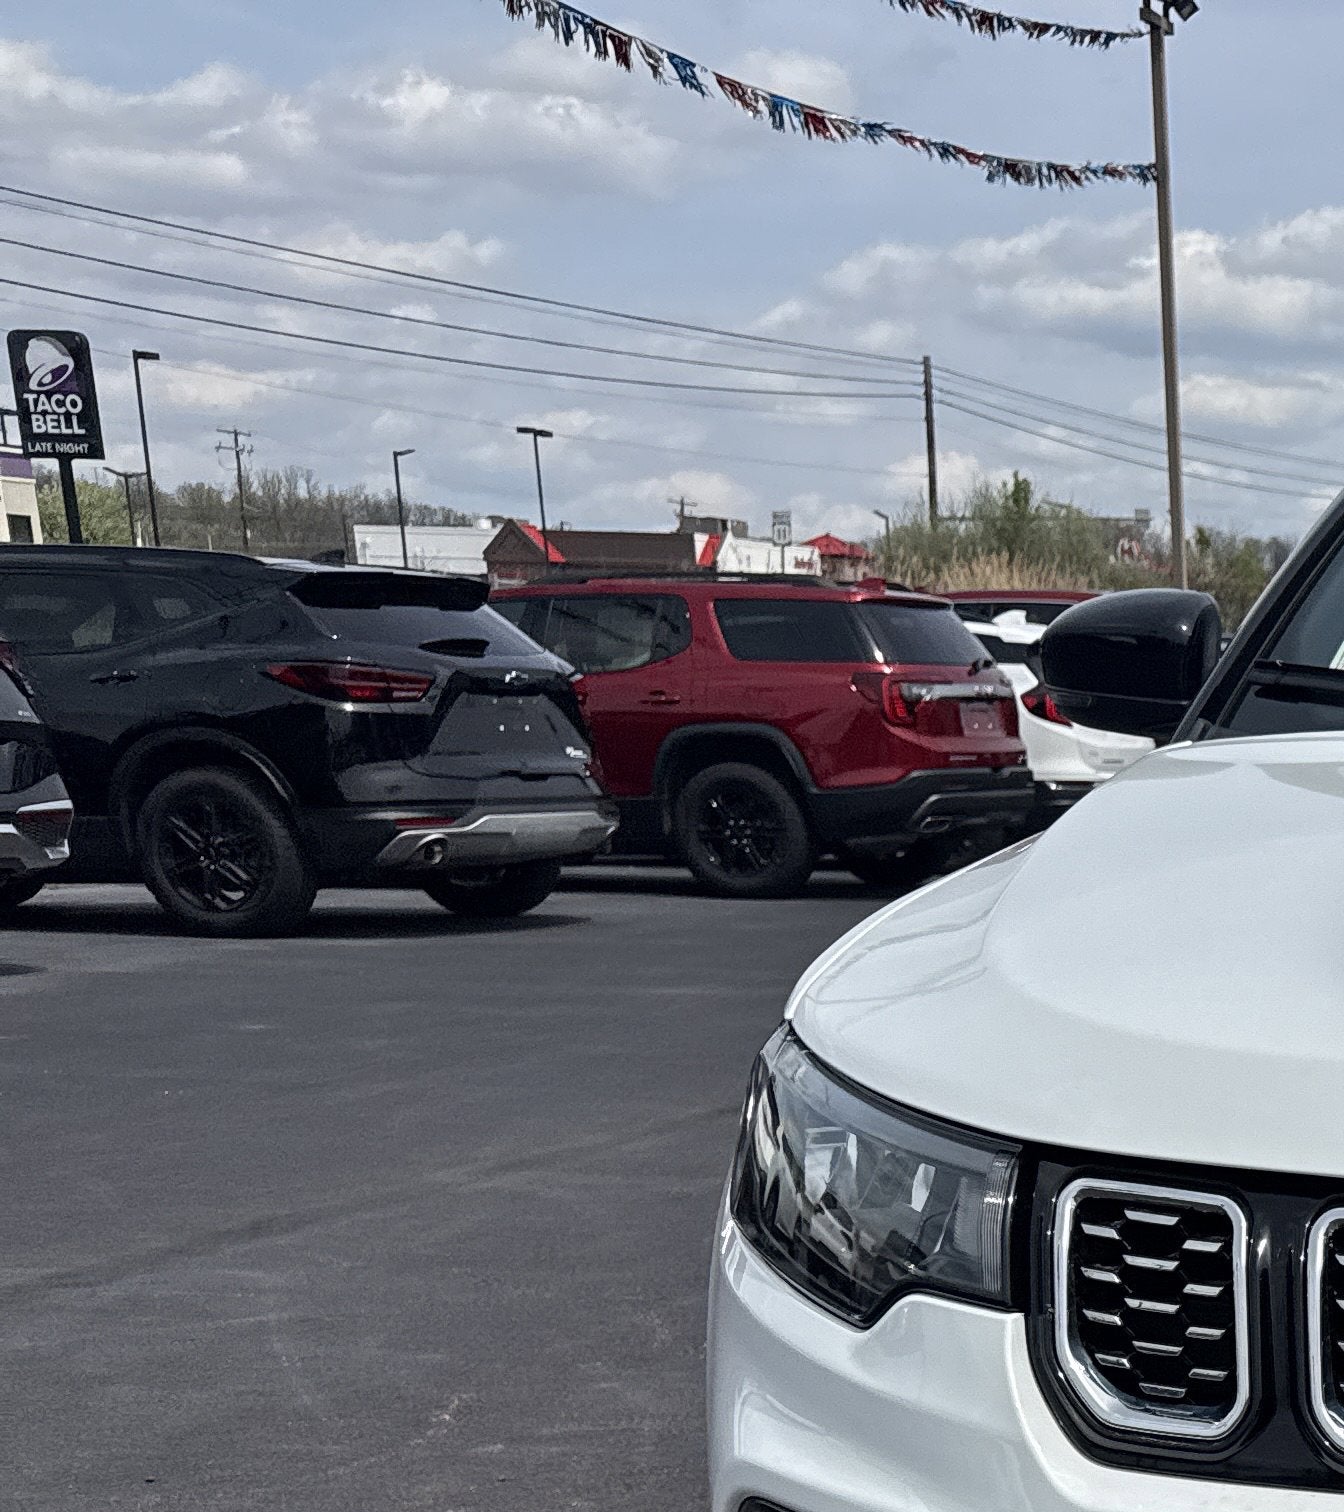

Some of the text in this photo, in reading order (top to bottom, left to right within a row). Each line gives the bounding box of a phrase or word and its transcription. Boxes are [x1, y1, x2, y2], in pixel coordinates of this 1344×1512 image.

[23, 394, 83, 414] TACO
[31, 414, 86, 434] BELL
[28, 442, 89, 454] LATE NIGHT
